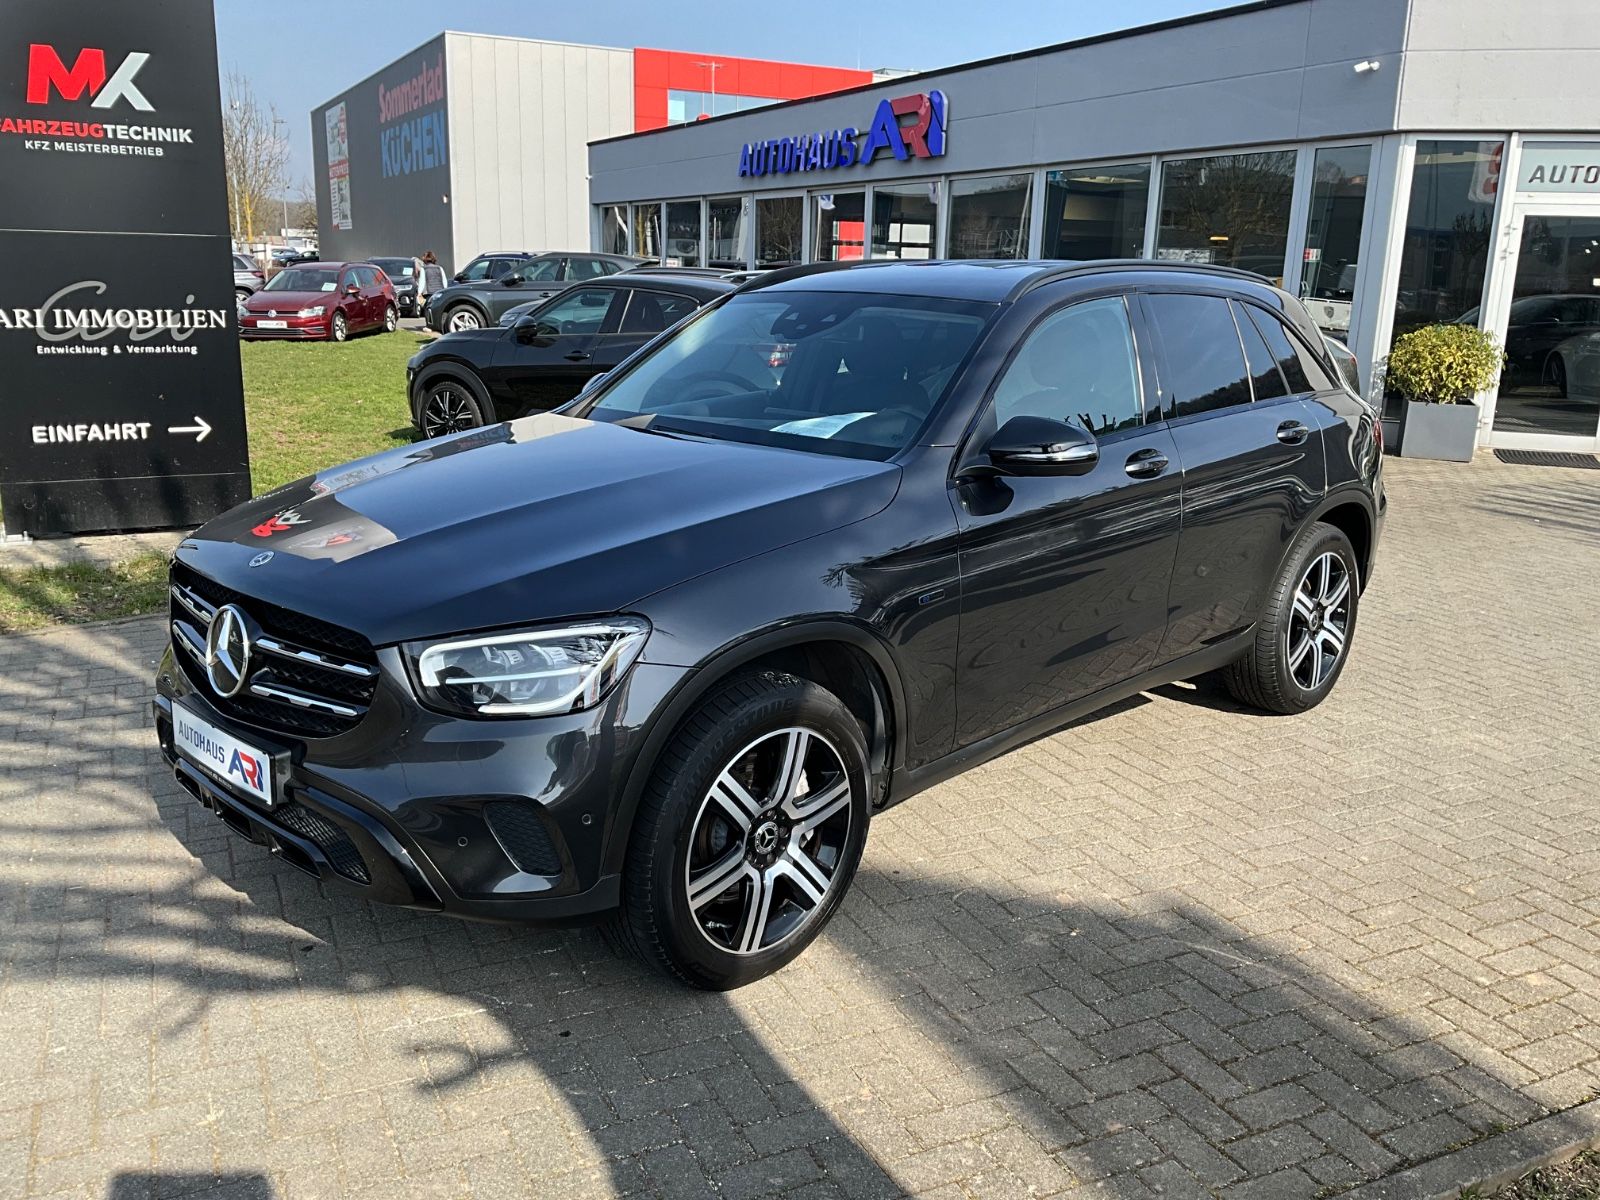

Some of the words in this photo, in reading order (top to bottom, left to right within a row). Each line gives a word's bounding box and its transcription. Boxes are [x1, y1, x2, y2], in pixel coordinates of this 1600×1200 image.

[27, 43, 156, 112] MK
[378, 53, 444, 123] Sommerlad
[0, 118, 193, 143] AHRZEUGTECHNIK
[25, 139, 50, 151] KFZ
[54, 141, 164, 156] MEISTERBETRIEB
[380, 110, 446, 178] KÜCHEN
[738, 127, 859, 177] AUTOHAUS
[860, 90, 948, 165] ARI
[0, 308, 45, 329] ARI
[54, 308, 227, 329] IMMOBILIEN
[36, 345, 108, 356] Entwicklung
[113, 345, 122, 354] &
[126, 344, 198, 355] Vermarktung
[32, 423, 152, 444] EINFAHRT
[178, 720, 225, 763] AUTOHAUS
[228, 748, 264, 792] ARI
